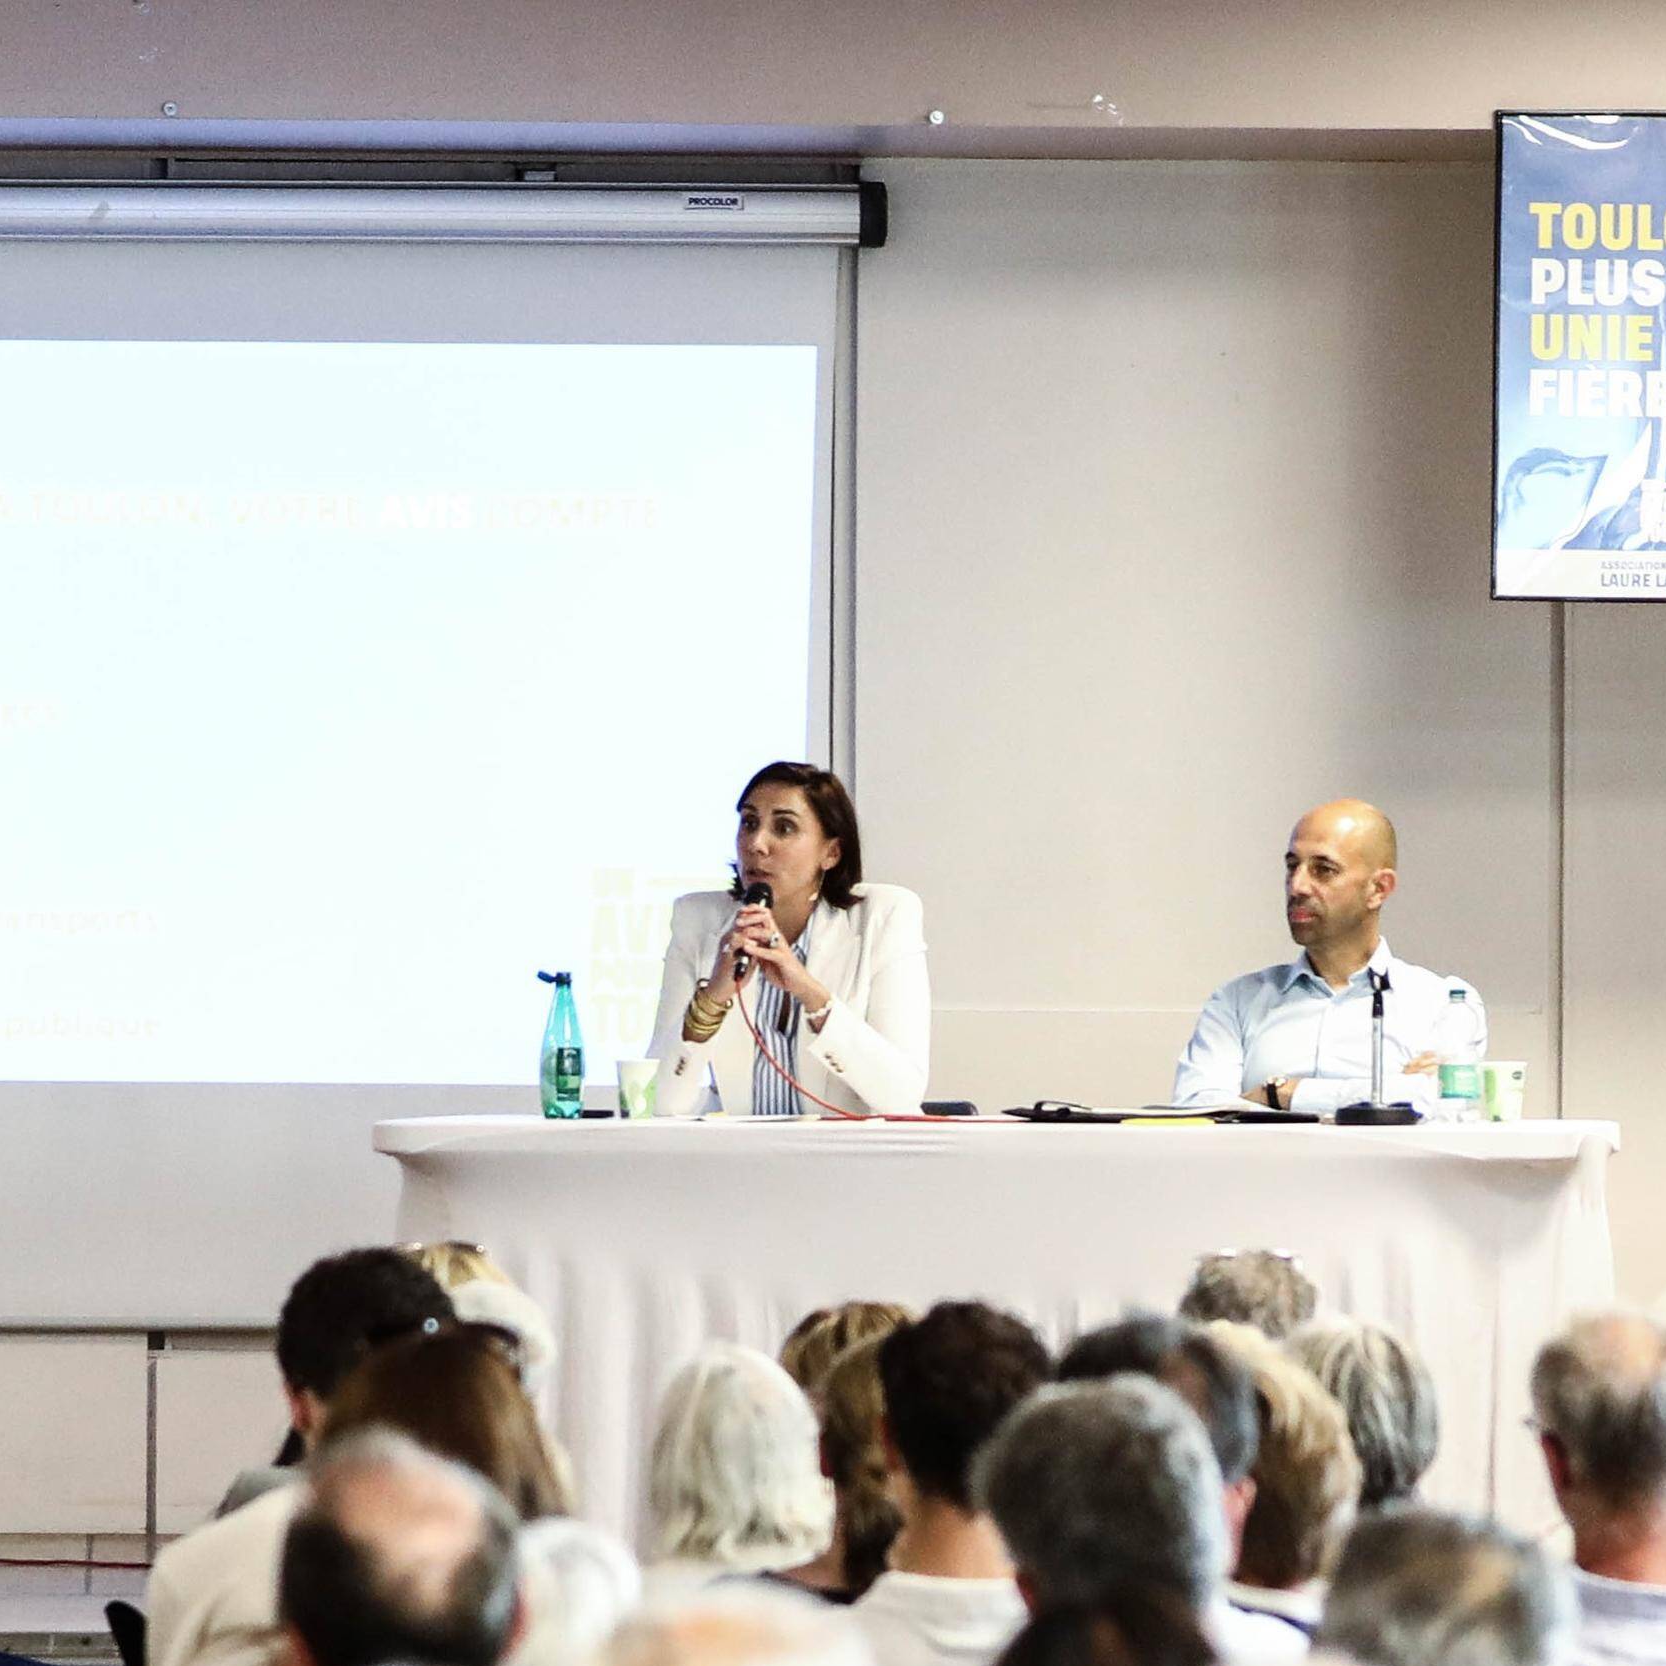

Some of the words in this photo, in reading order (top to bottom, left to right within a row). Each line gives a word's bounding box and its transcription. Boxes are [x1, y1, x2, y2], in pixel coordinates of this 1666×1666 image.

[688, 197, 739, 206] PROCOLOR
[1530, 258, 1665, 307] PLUS
[1529, 314, 1654, 362] UNIE
[1601, 573, 1650, 587] LAURE
